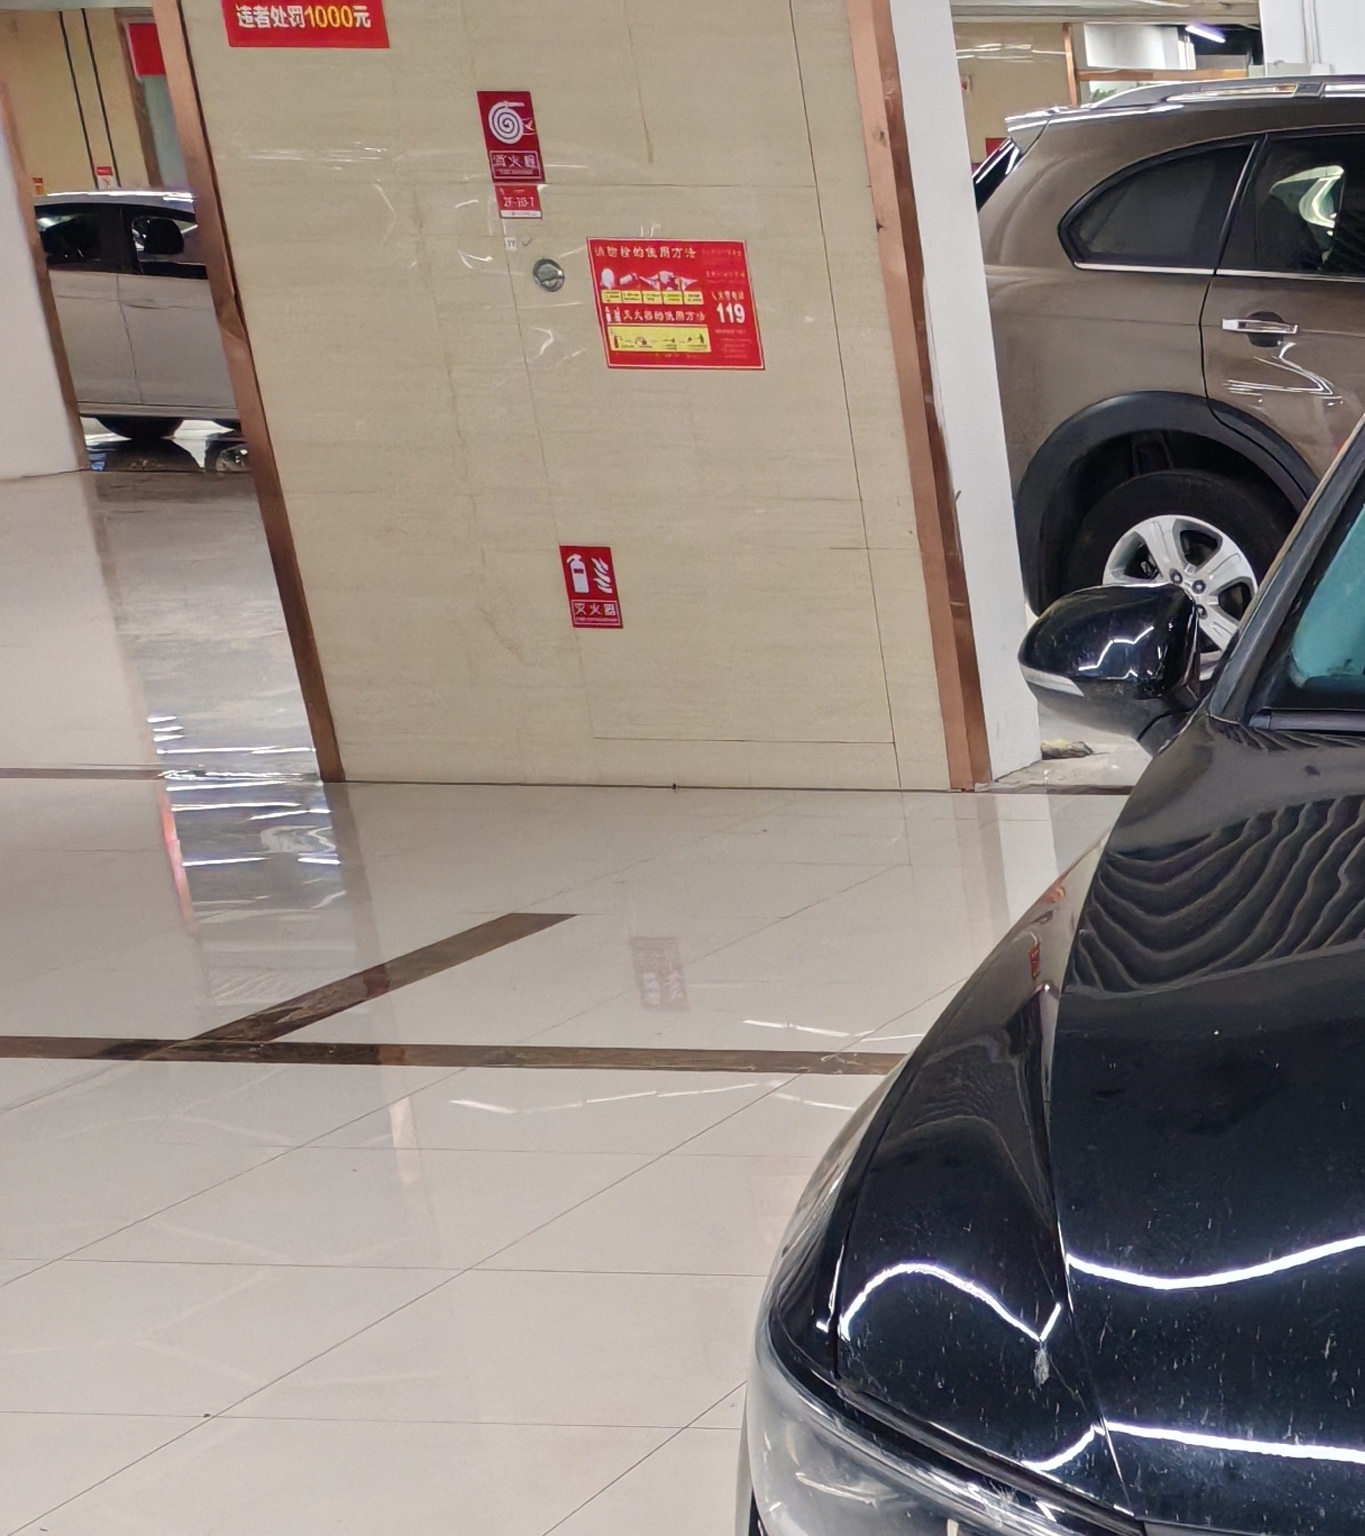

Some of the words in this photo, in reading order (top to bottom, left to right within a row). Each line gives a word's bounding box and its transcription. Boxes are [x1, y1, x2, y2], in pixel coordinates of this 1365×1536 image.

[236, 4, 371, 28] 违者处罚1000元
[716, 302, 746, 323] 119
